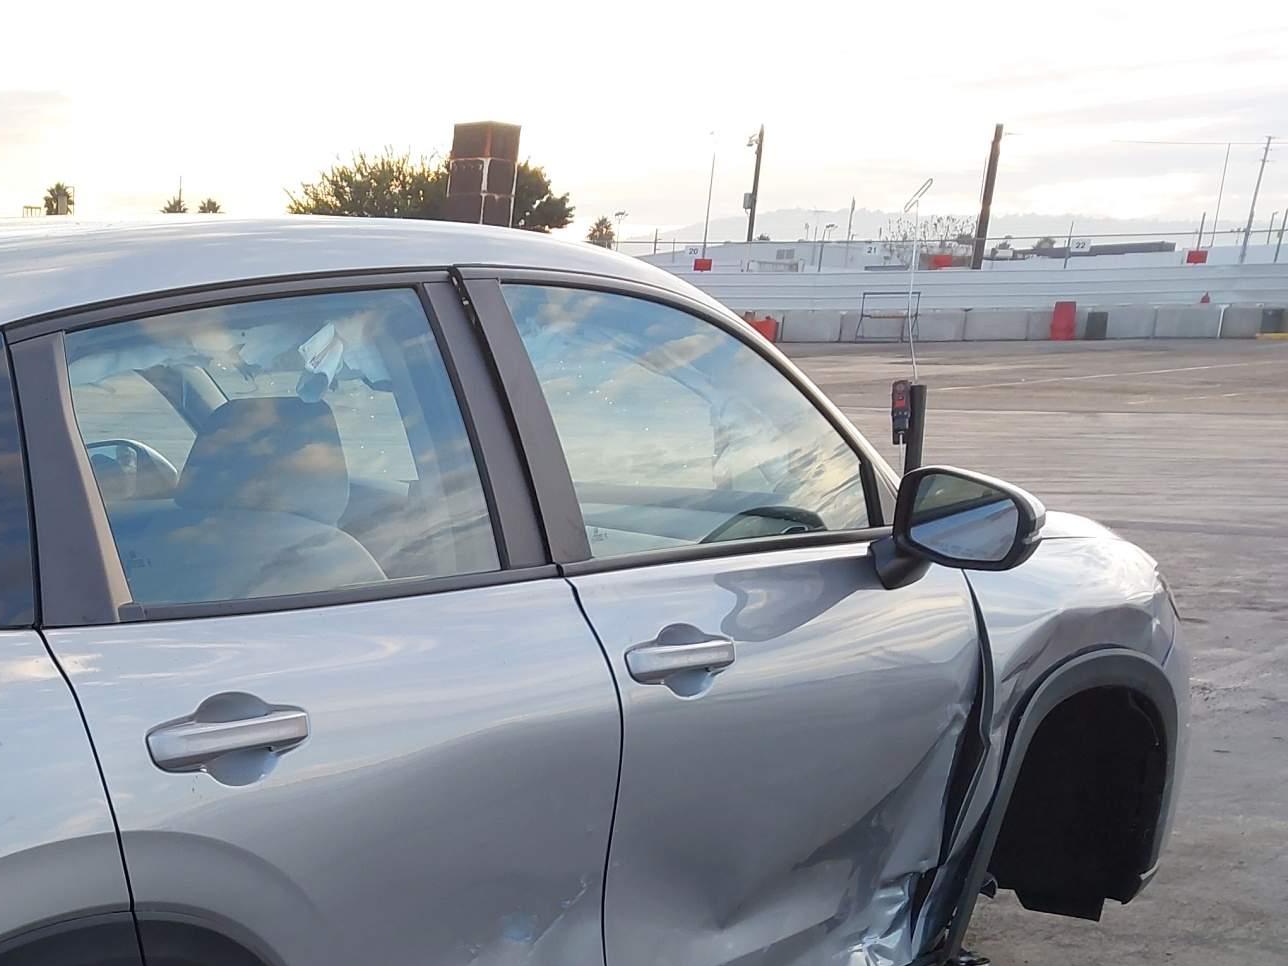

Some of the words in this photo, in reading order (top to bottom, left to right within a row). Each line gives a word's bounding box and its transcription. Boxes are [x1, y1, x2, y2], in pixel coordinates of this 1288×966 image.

[1075, 241, 1086, 249] 22
[688, 247, 699, 255] 20
[867, 246, 877, 254] 21
